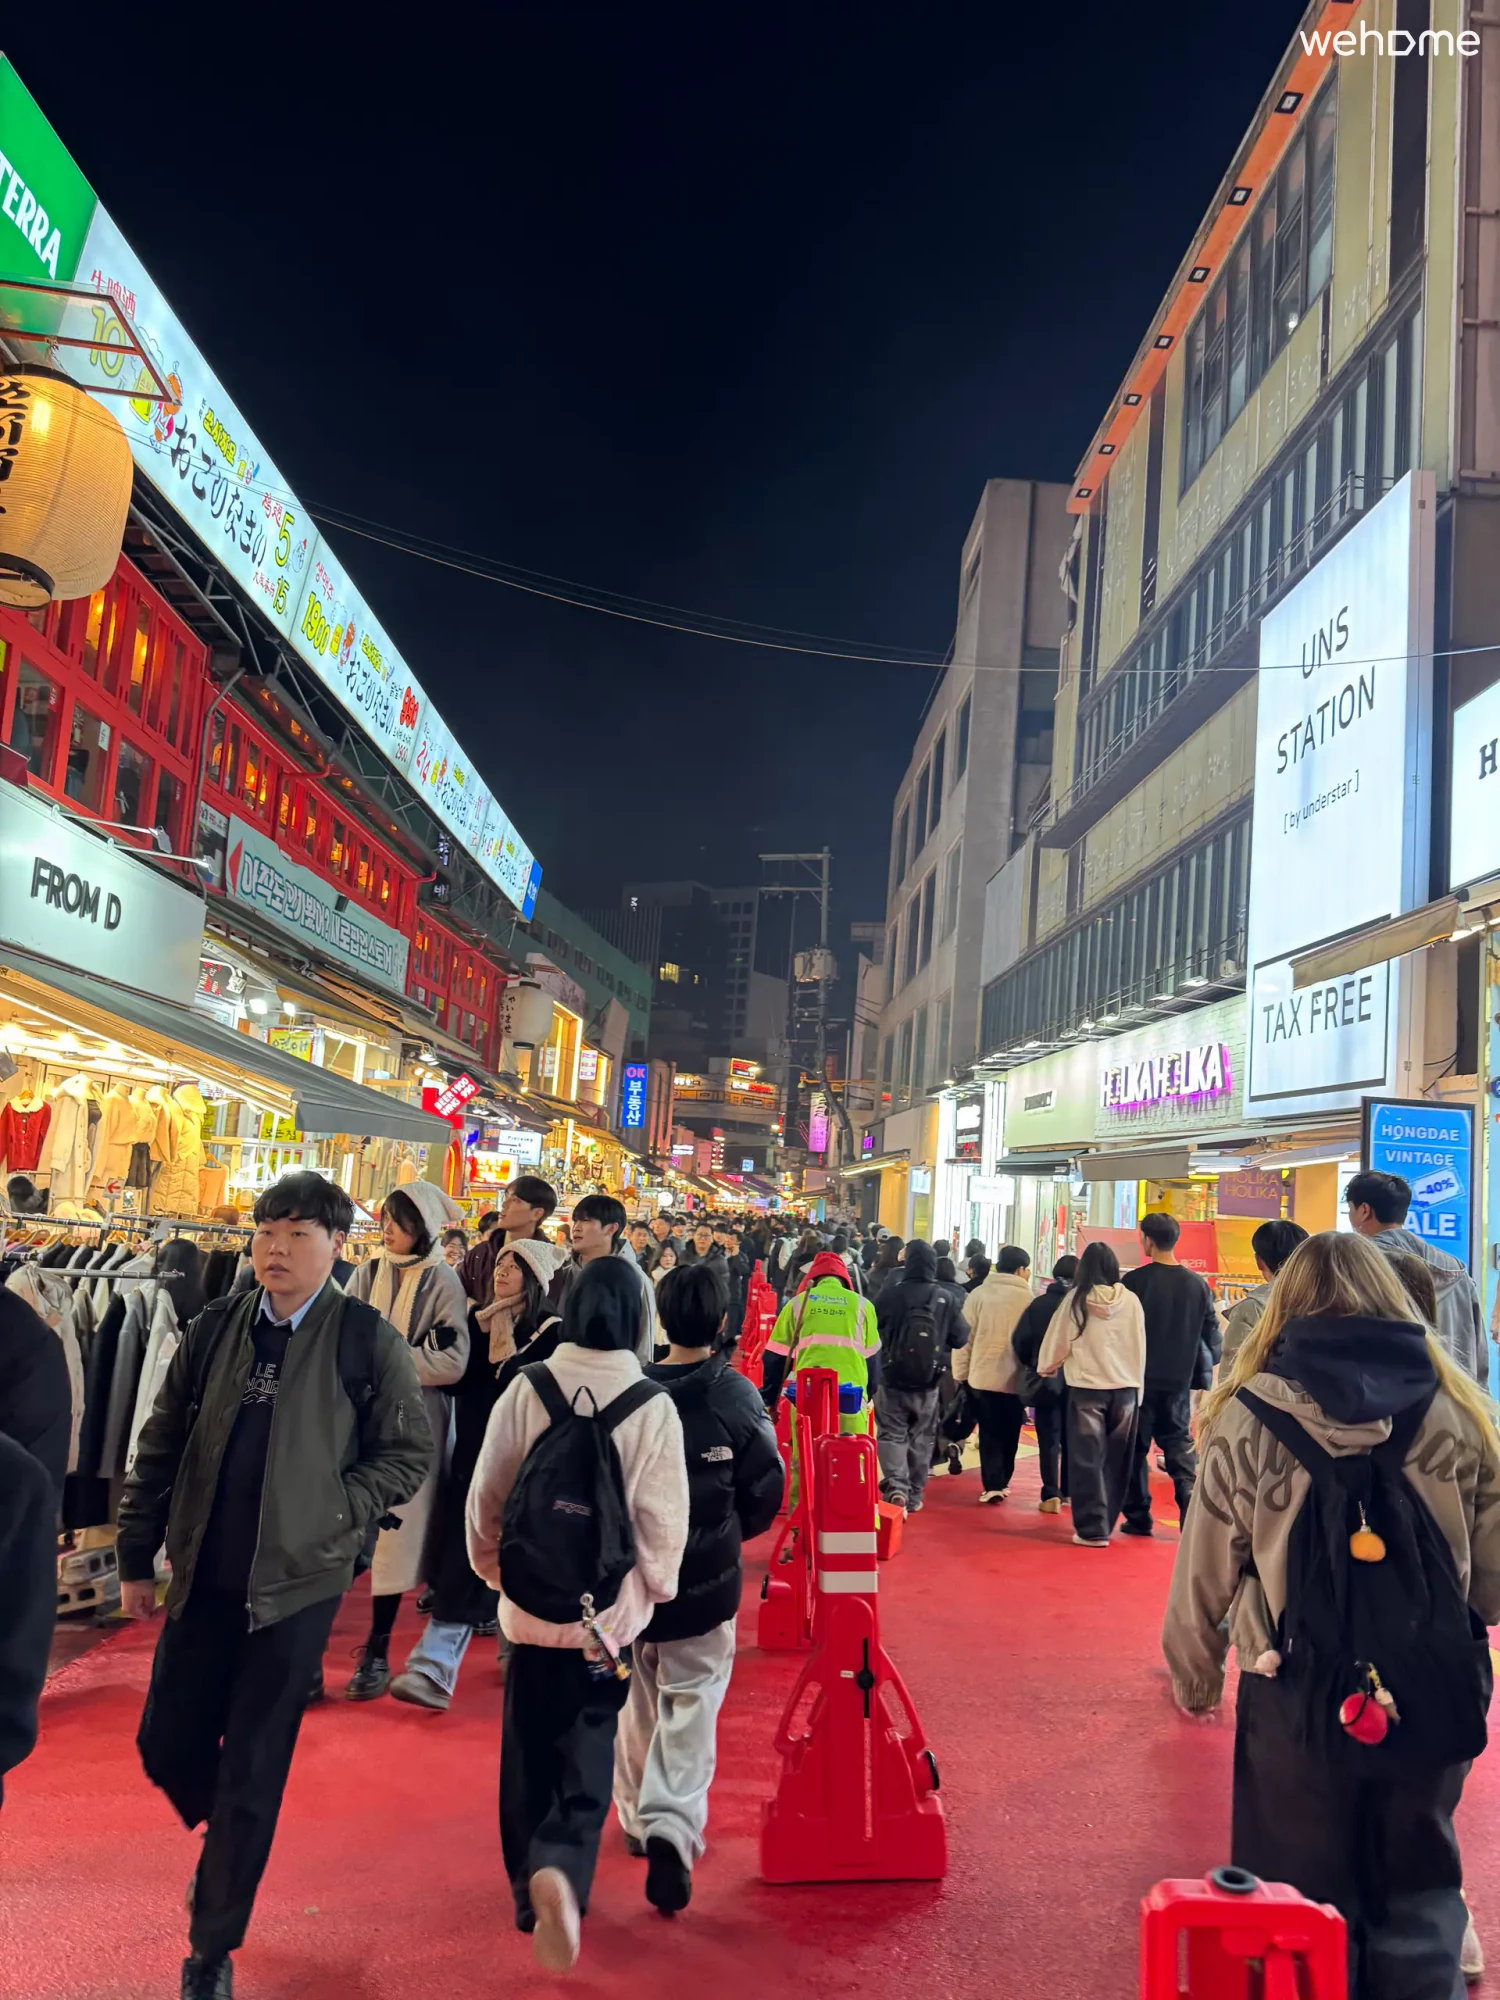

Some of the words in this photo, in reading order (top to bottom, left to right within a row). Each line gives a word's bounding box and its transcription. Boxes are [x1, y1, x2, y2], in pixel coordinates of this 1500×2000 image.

[0, 150, 61, 279] TERRA
[90, 304, 126, 378] 10
[275, 511, 295, 567] 5
[273, 575, 290, 615] 15
[315, 561, 335, 601] 생맥주
[301, 591, 330, 656] 1900
[1302, 605, 1349, 680] UNS
[1276, 665, 1375, 774] STATION
[1290, 807, 1301, 829] by
[1302, 777, 1352, 820] understar
[30, 856, 101, 924] FROM
[104, 892, 122, 931] D
[1263, 994, 1303, 1044] TAX
[1310, 975, 1373, 1033] FREE
[626, 1066, 646, 1079] OK
[434, 1091, 454, 1110] BEER
[440, 1097, 461, 1116] WING
[626, 1080, 643, 1126] 부동산
[1381, 1124, 1460, 1142] HONGDAE
[1385, 1149, 1455, 1166] VINTAGE
[1224, 1170, 1279, 1186] HOLIKA
[1224, 1184, 1278, 1199] HOLIKA
[1418, 1177, 1455, 1195] -40%
[1402, 1210, 1457, 1237] ALE
[256, 1362, 277, 1378] LE
